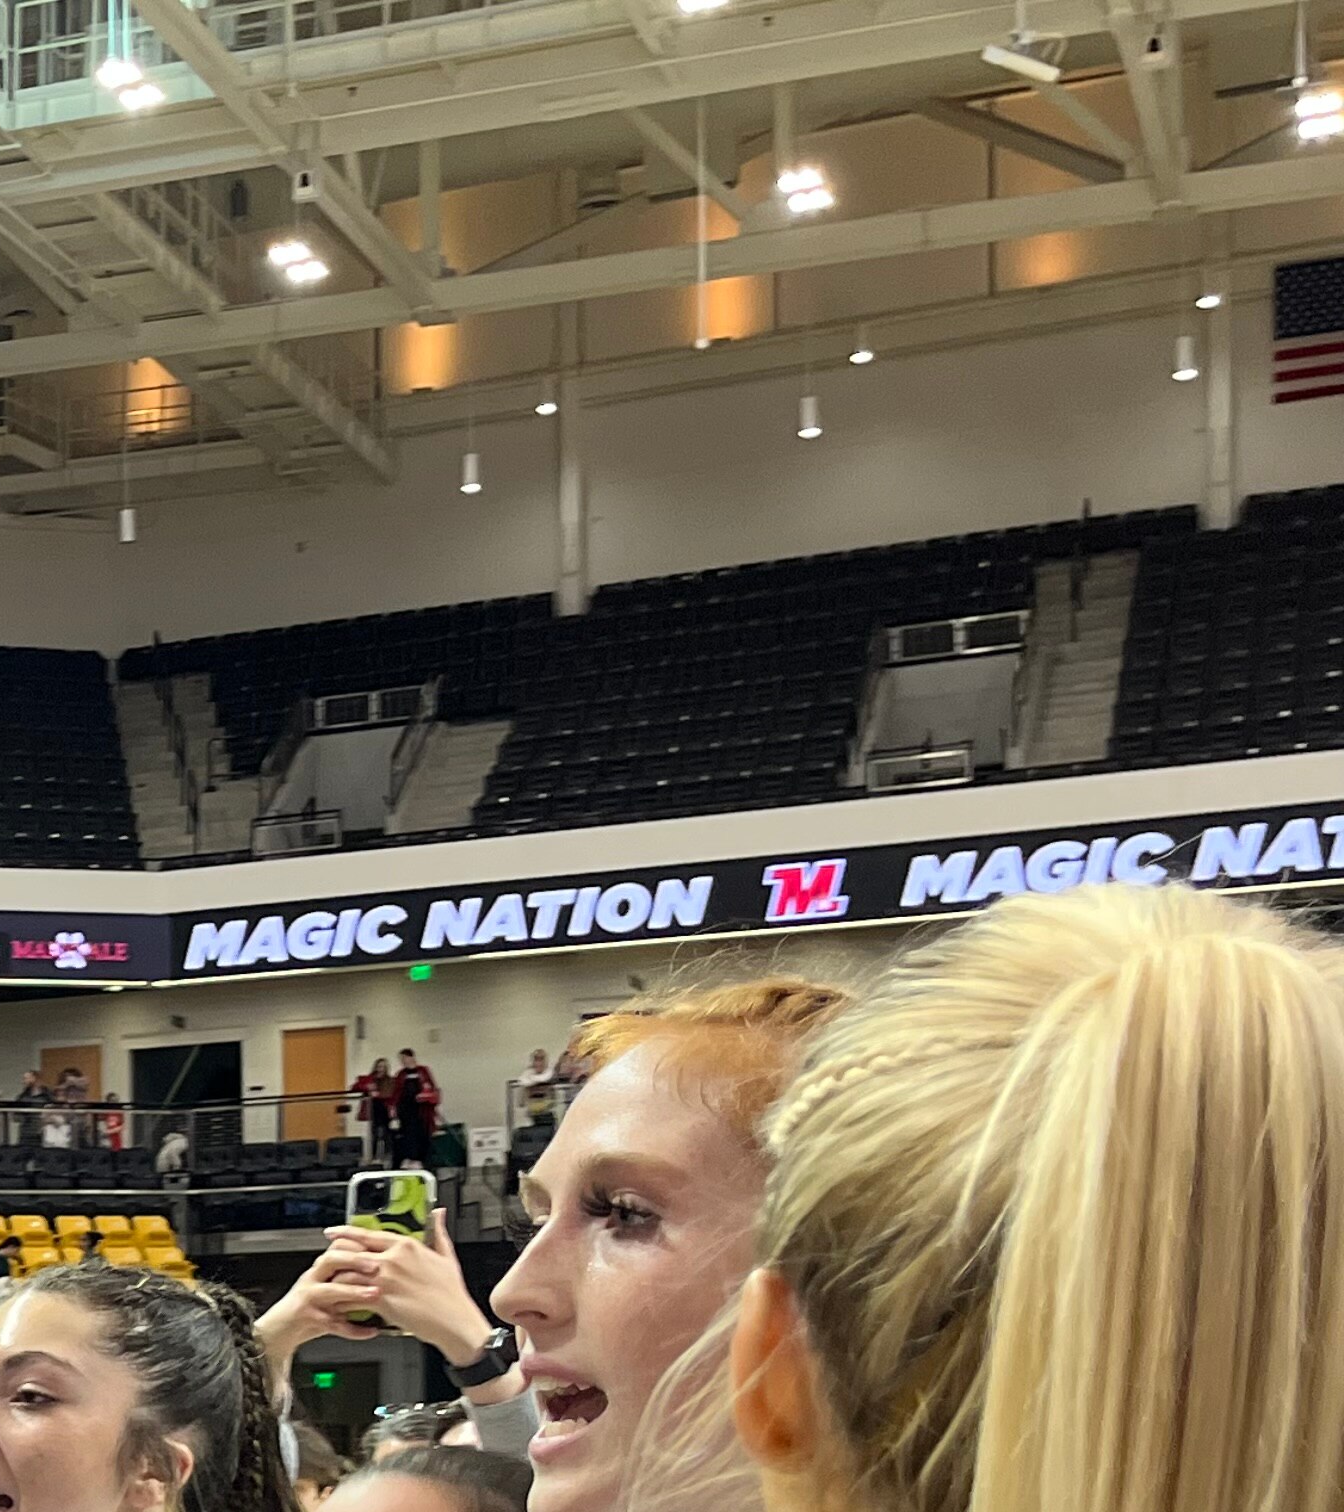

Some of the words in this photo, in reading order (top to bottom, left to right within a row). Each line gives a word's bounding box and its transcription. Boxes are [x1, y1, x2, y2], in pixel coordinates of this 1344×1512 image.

[900, 831, 1175, 908] MAGIC
[184, 905, 408, 971] MAGIC
[421, 876, 712, 950] NATION
